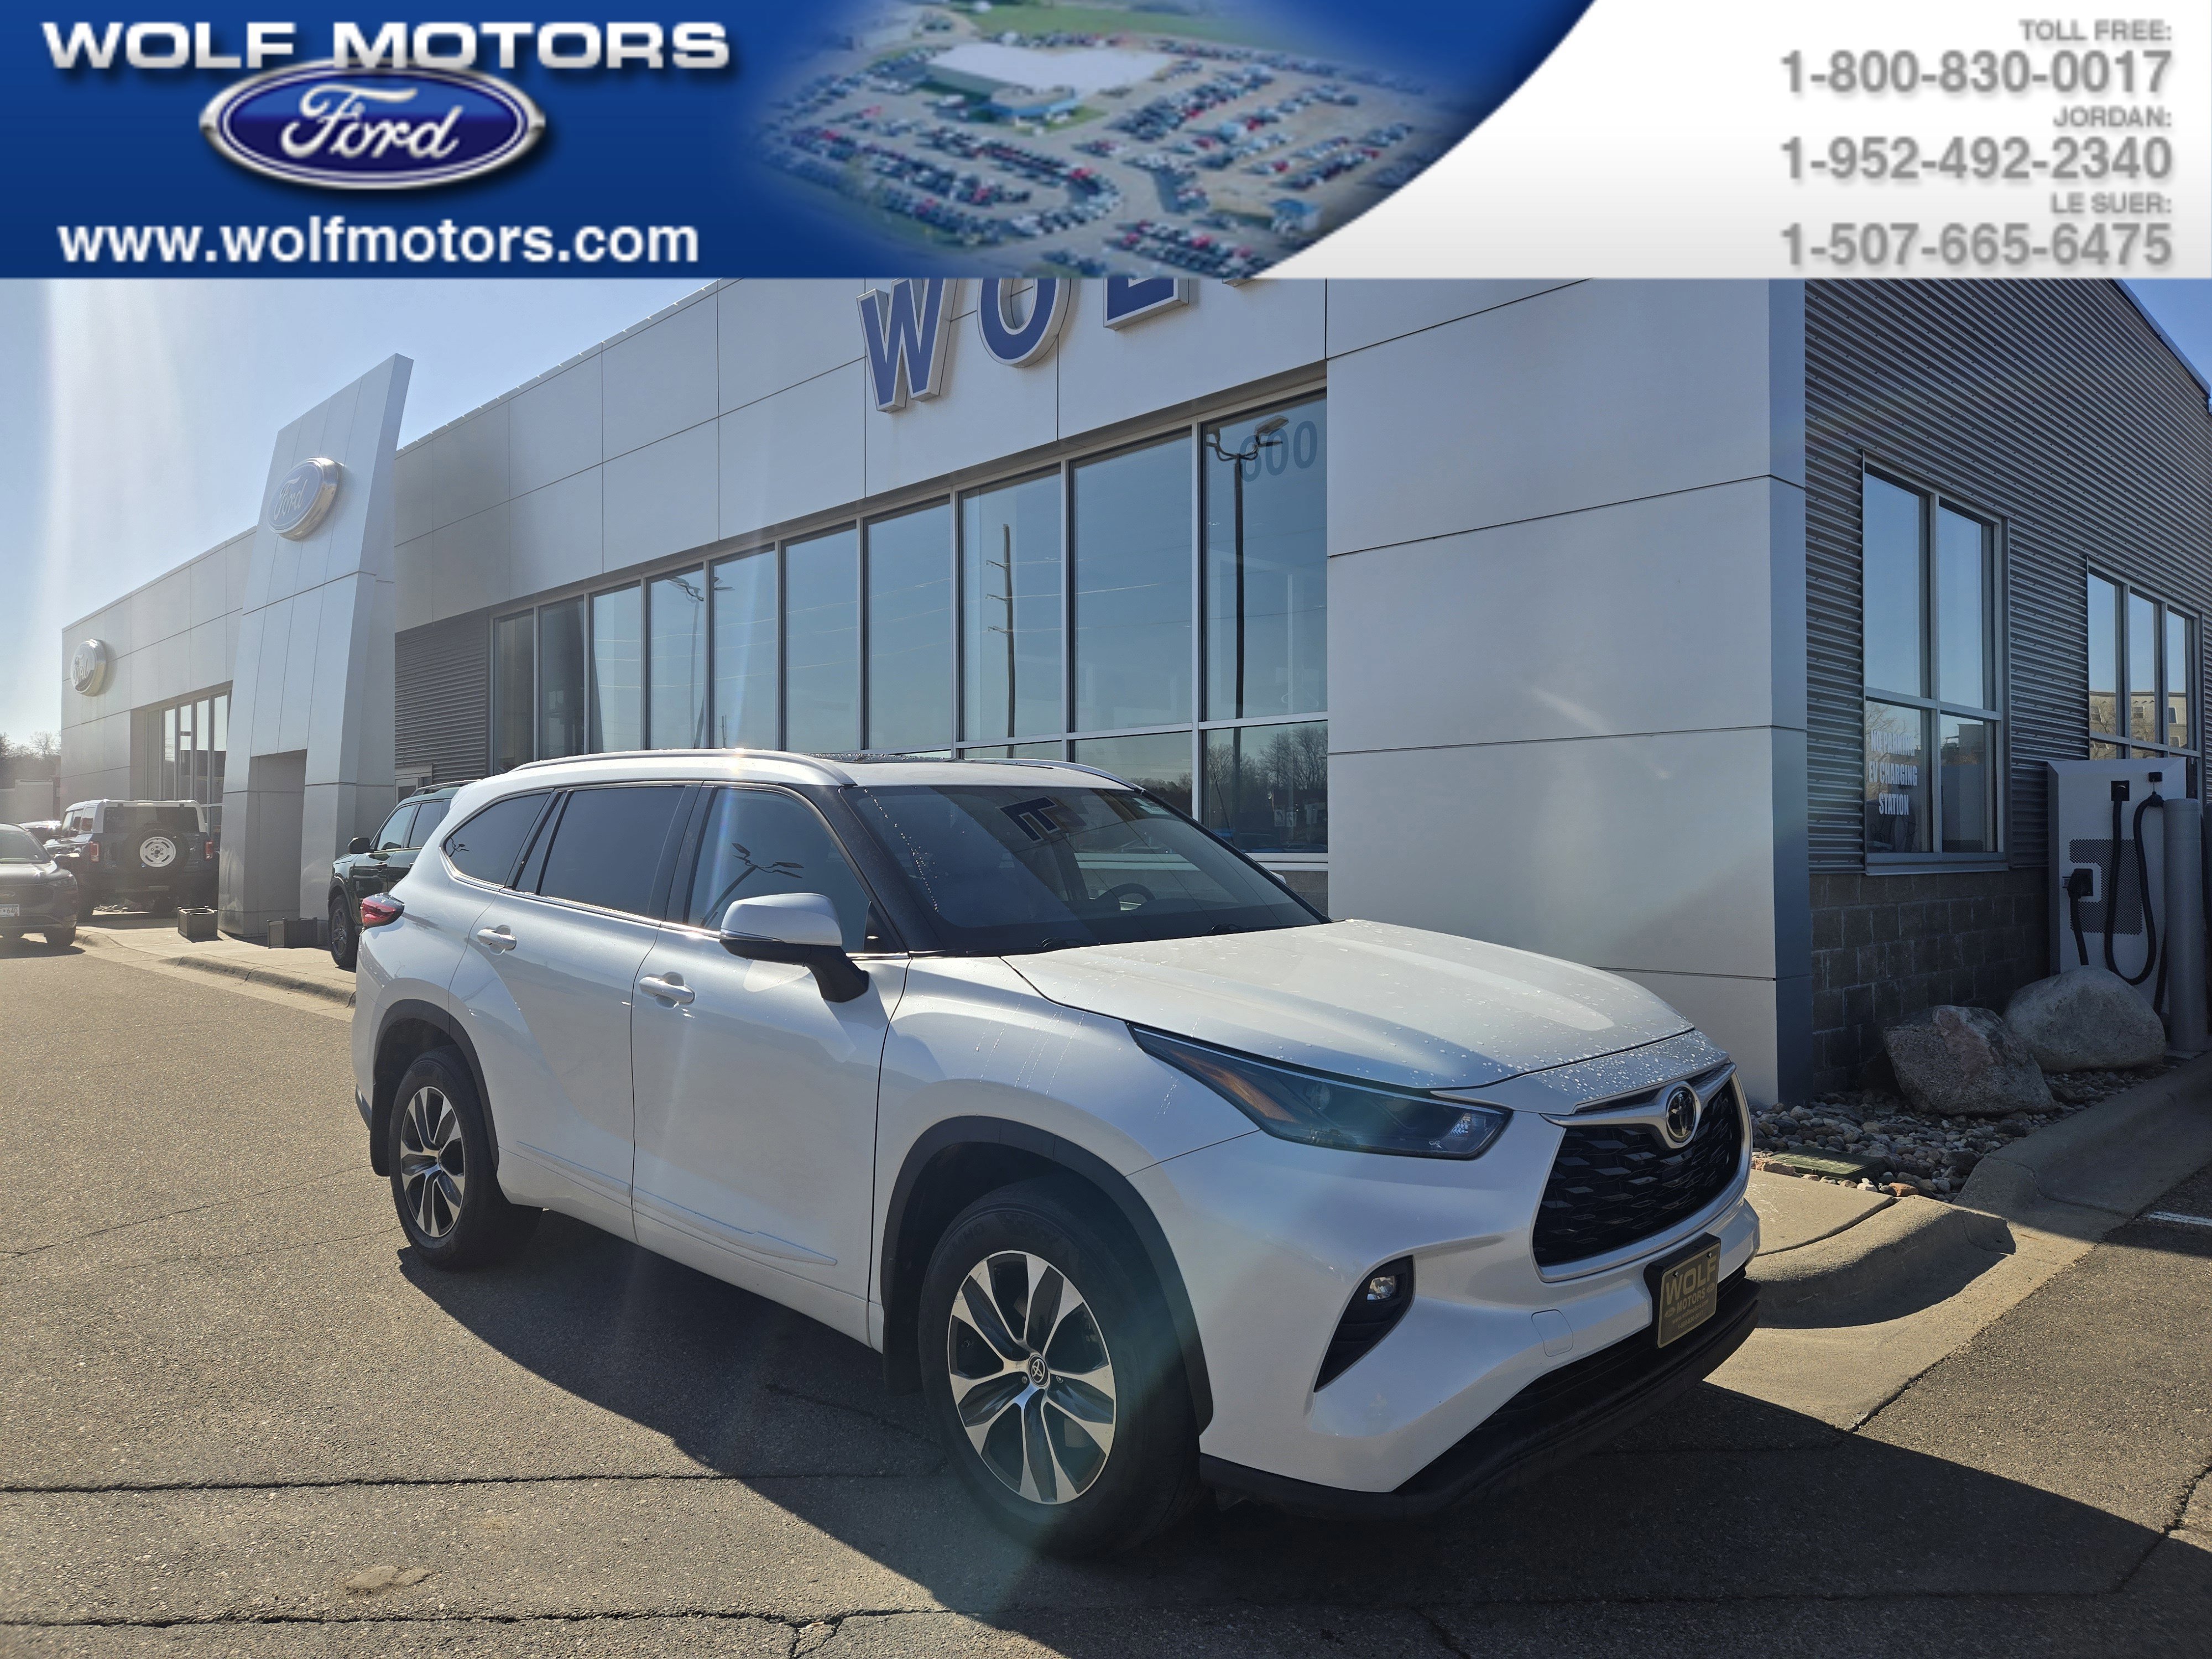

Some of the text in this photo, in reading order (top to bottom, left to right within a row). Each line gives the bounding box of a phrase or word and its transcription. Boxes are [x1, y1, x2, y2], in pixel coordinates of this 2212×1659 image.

[1239, 420, 1318, 482] 600
[273, 475, 309, 521] Ford
[1871, 731, 1915, 757] NO PARKING
[1869, 761, 1918, 786] EV CHARGING
[1879, 792, 1909, 815] STATION
[1666, 1255, 1717, 1306] WOLF
[1677, 1287, 1705, 1314] MOTORS
